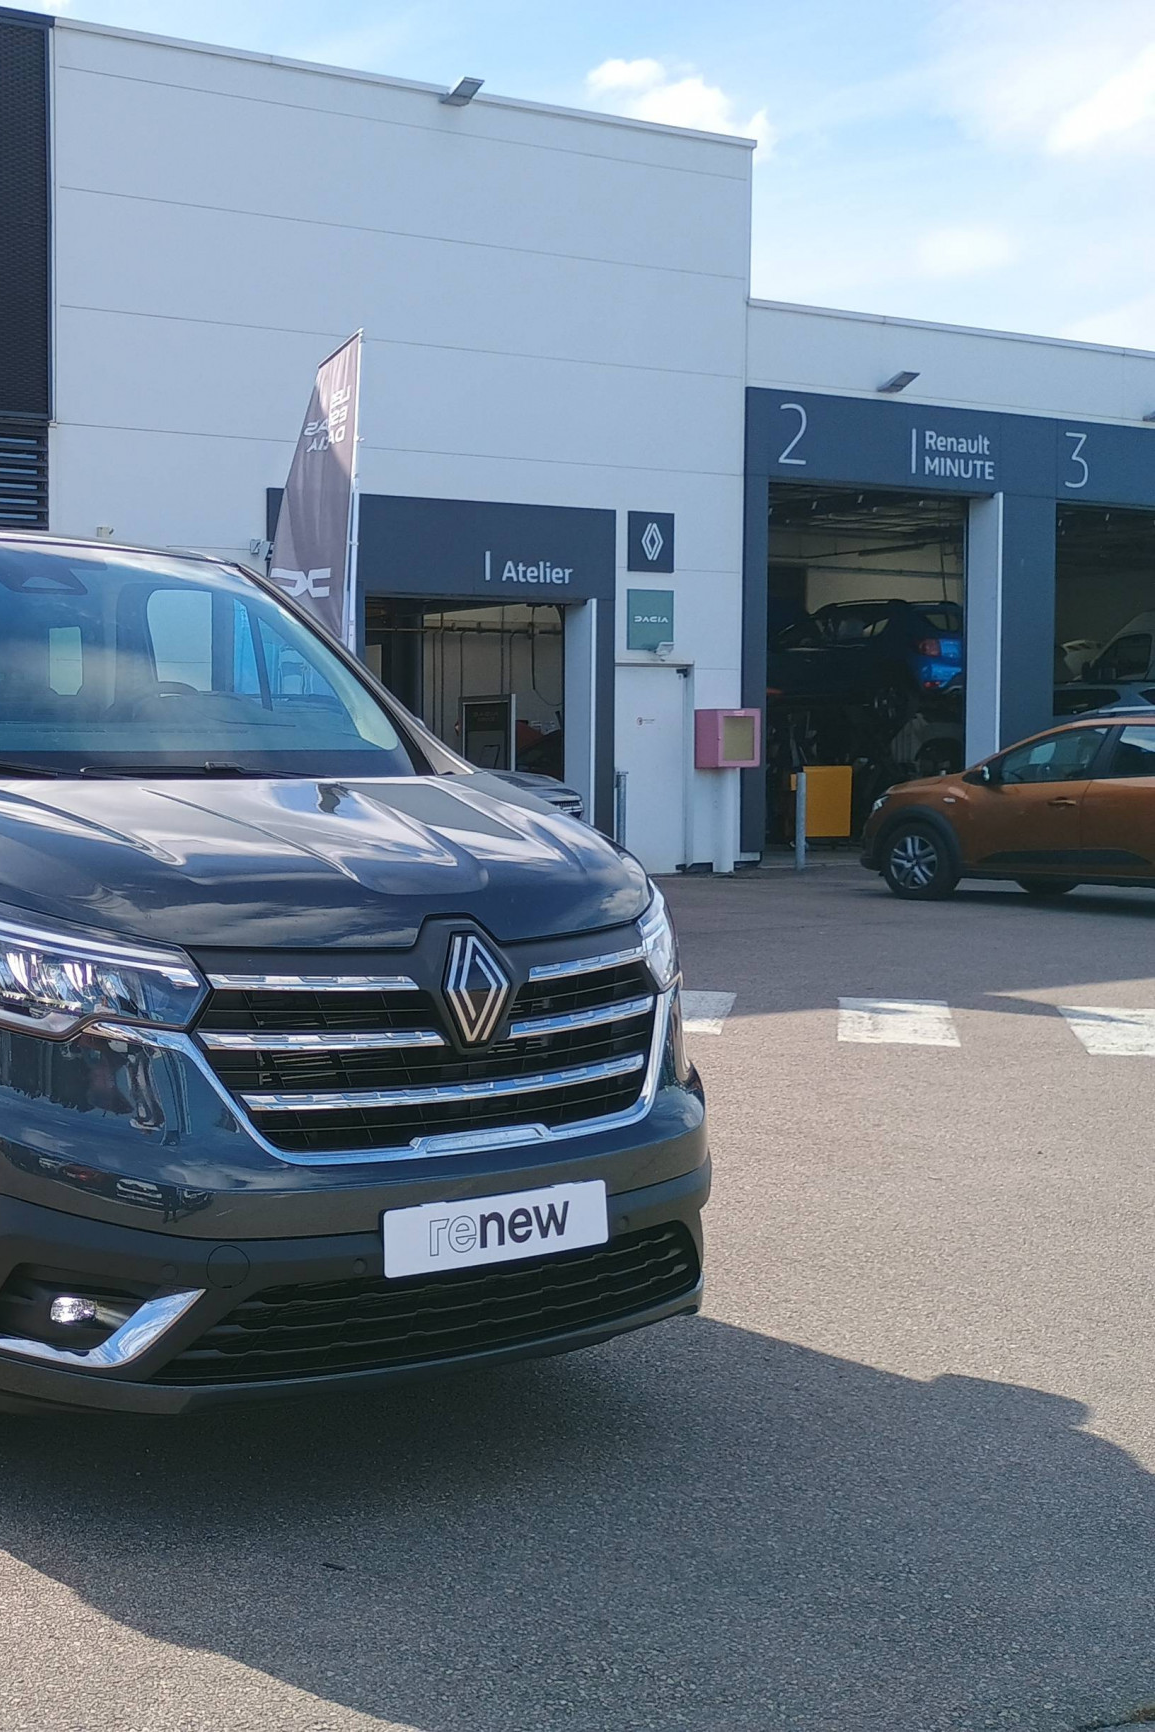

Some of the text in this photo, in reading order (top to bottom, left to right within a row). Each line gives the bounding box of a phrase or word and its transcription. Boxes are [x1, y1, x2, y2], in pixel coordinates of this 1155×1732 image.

[778, 403, 807, 465] 2
[924, 430, 991, 456] Renault
[924, 456, 995, 481] MINUTE
[1064, 431, 1089, 488] 3
[501, 560, 574, 584] Atelier
[633, 615, 669, 624] DACIA
[429, 1201, 570, 1257] renew
